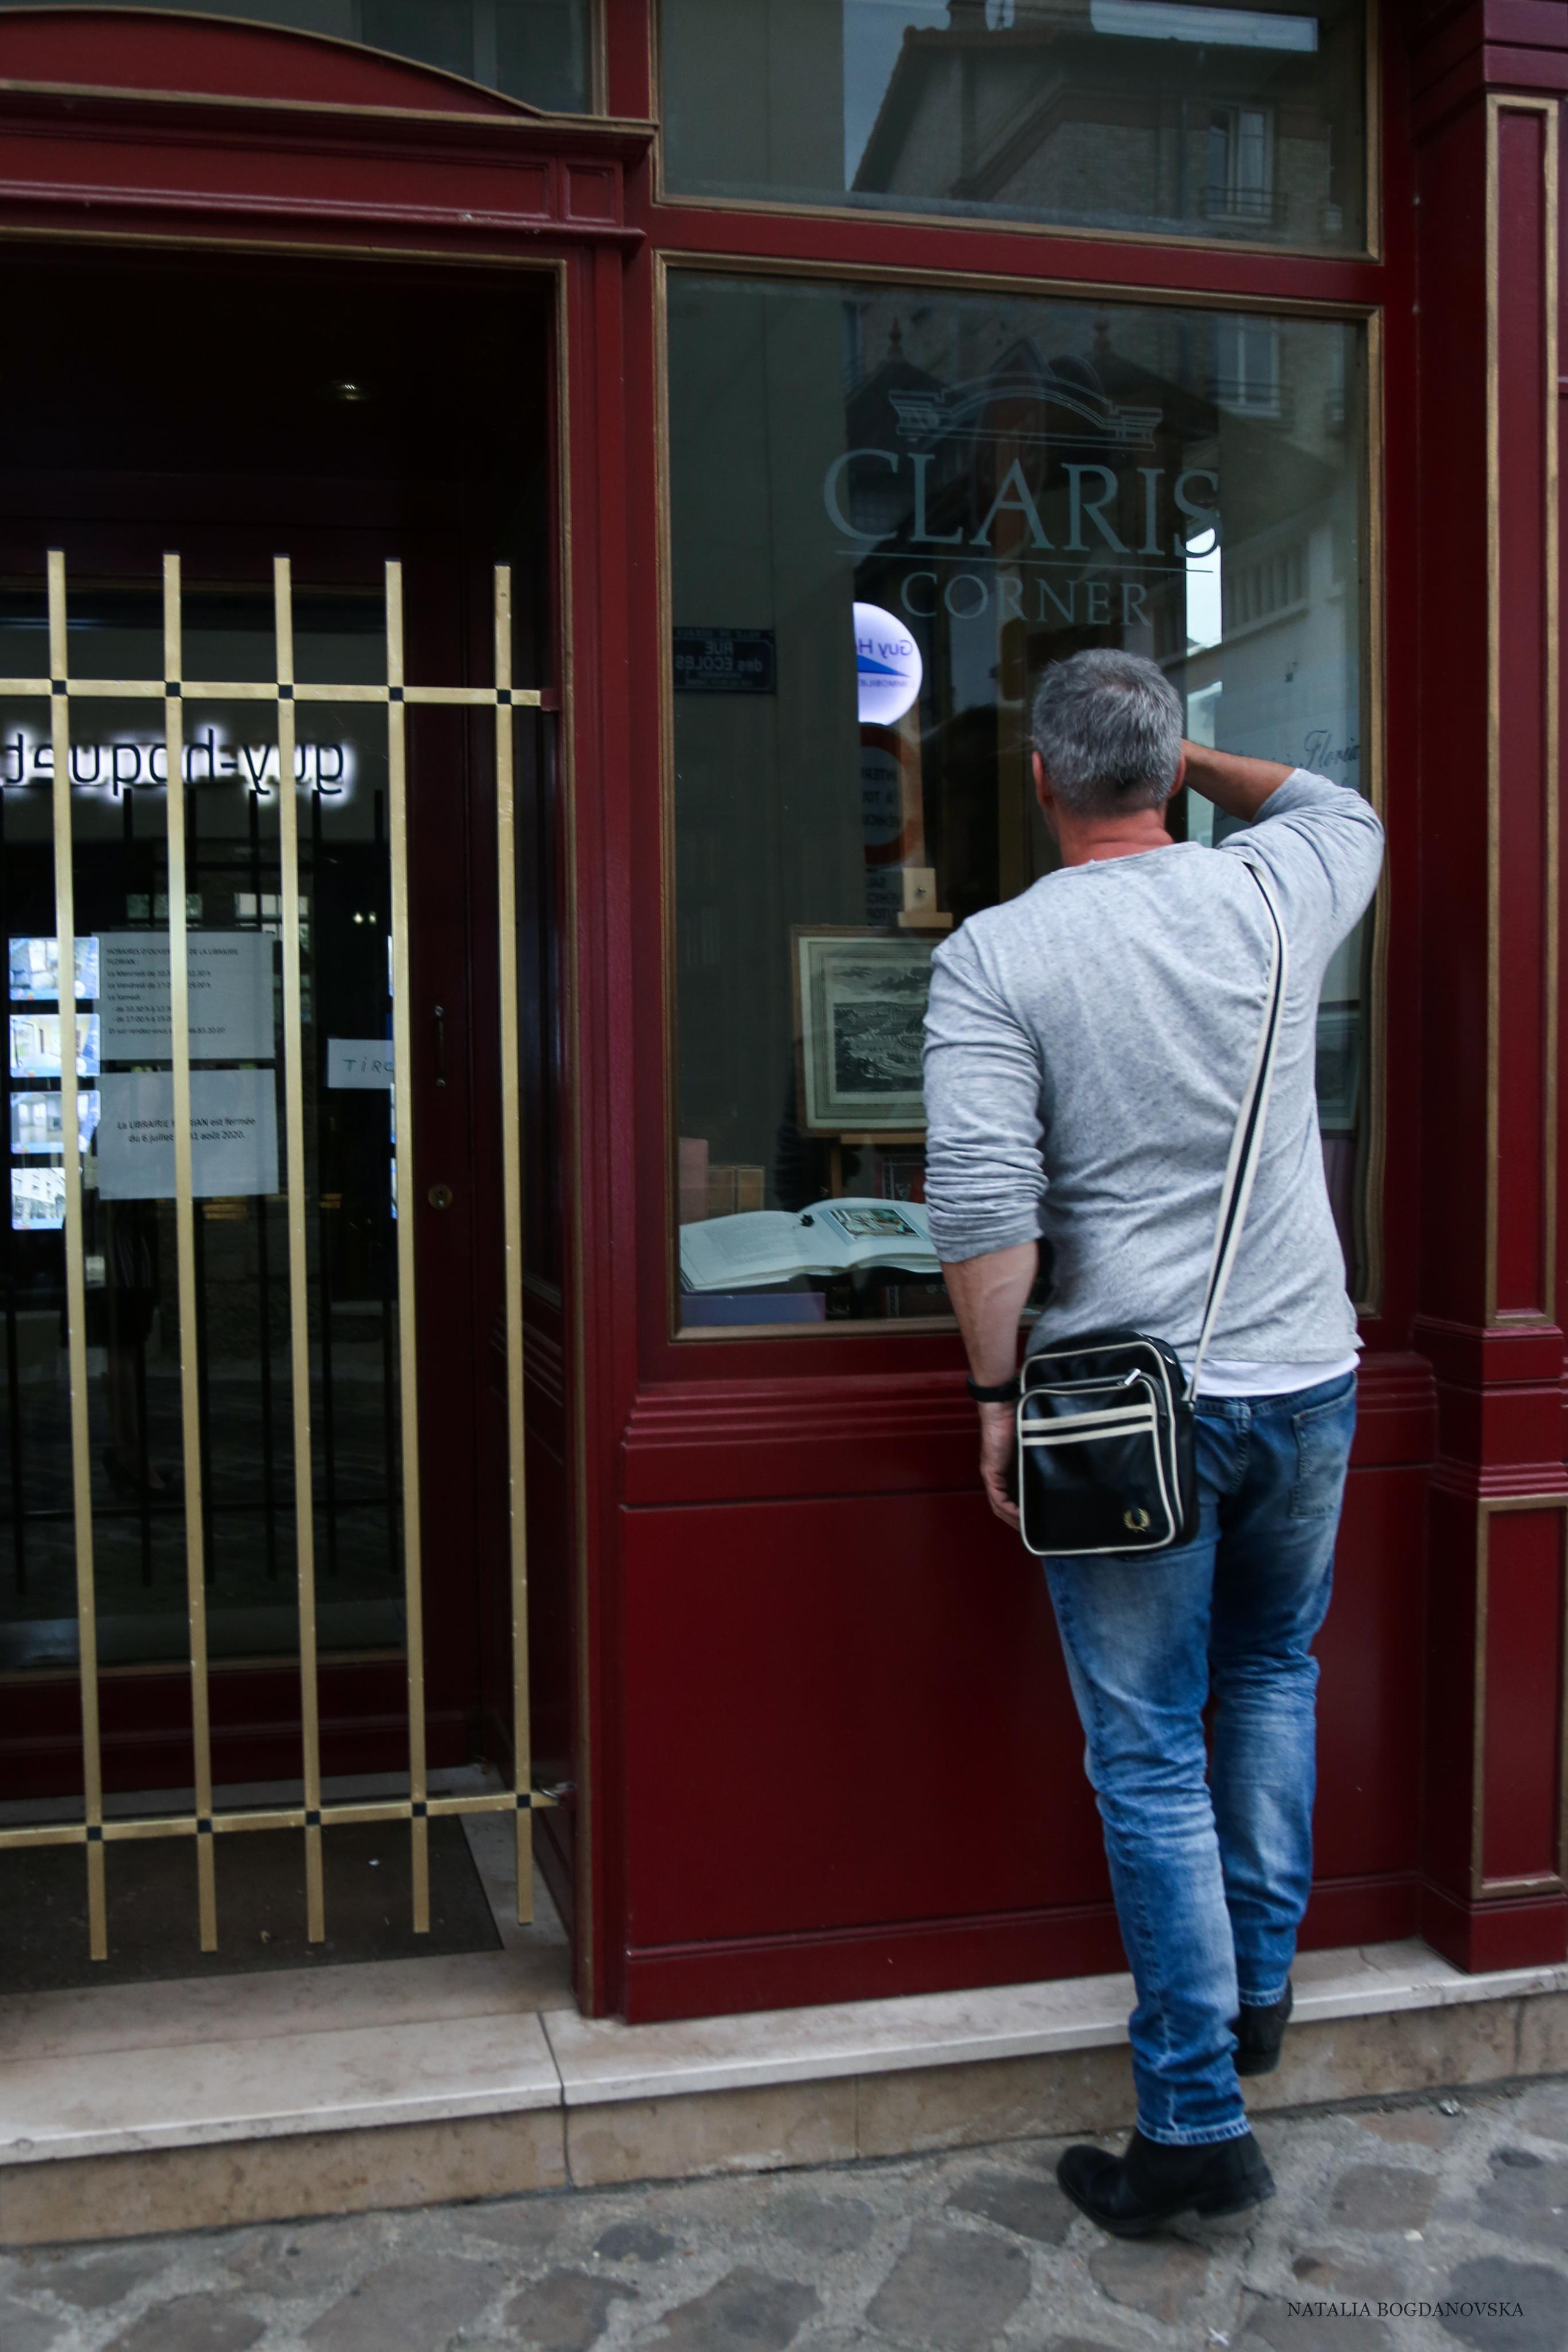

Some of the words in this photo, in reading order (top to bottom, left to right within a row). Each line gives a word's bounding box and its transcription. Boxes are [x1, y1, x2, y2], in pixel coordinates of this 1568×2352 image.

[824, 448, 1221, 558] CLARIS
[900, 572, 1152, 627] CORNER
[116, 1121, 127, 1129] La
